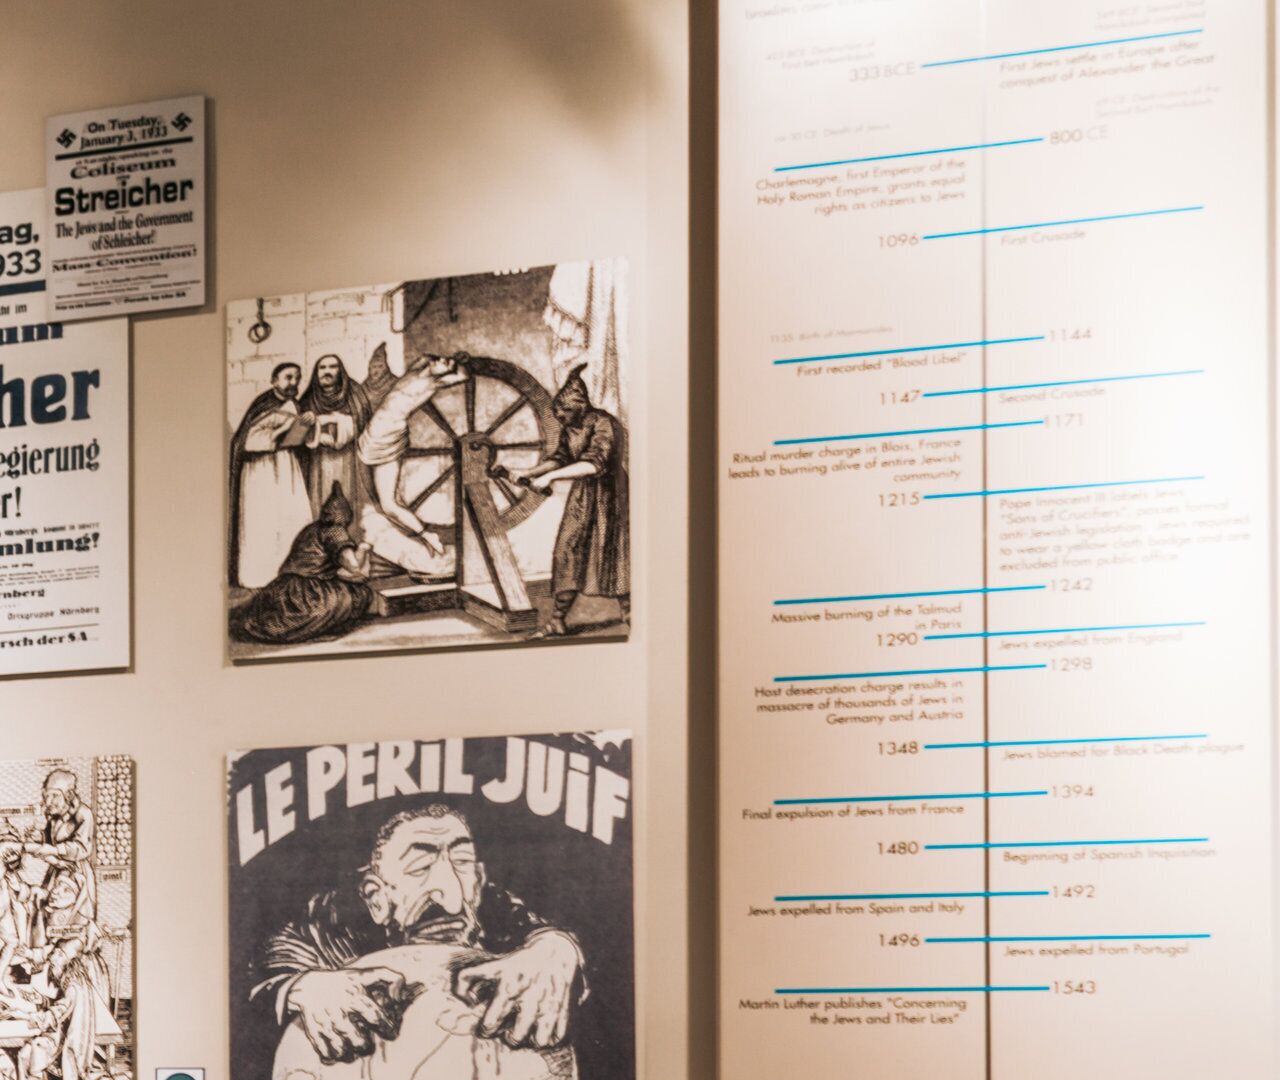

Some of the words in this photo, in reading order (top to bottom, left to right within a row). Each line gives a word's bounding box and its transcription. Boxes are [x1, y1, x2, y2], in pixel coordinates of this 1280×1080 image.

[88, 122, 105, 134] On
[110, 116, 161, 131] Tuesday,
[80, 133, 123, 150] January
[141, 127, 168, 139] 1933
[70, 158, 176, 180] Coliseum
[55, 177, 193, 216] Streicher
[55, 223, 73, 238] The
[75, 221, 97, 239] Jews
[99, 217, 116, 232] and
[118, 216, 133, 230] the
[135, 211, 193, 228] Government
[92, 238, 102, 251] of
[877, 234, 919, 248] 1096
[53, 262, 91, 272] Mass
[15, 302, 28, 313] im
[879, 390, 921, 406] 1147
[878, 491, 920, 507] 1215
[876, 632, 918, 647] 1290
[877, 741, 919, 756] 1348
[1051, 785, 1094, 799] 1394
[236, 760, 296, 867] LE
[742, 808, 772, 822] Final
[775, 806, 834, 823] expulsion
[837, 806, 851, 818] of
[854, 805, 883, 818] Jews
[887, 804, 917, 818] from
[921, 803, 965, 817] France
[877, 841, 919, 855] 1480
[1051, 884, 1096, 899] 1492
[747, 905, 776, 918] Jews
[779, 904, 832, 919] expelled
[835, 903, 864, 917] from
[869, 903, 903, 918] Spain
[907, 902, 935, 915] and
[938, 901, 965, 917] Italy
[878, 932, 920, 947] 1496
[1052, 980, 1096, 995] 1543
